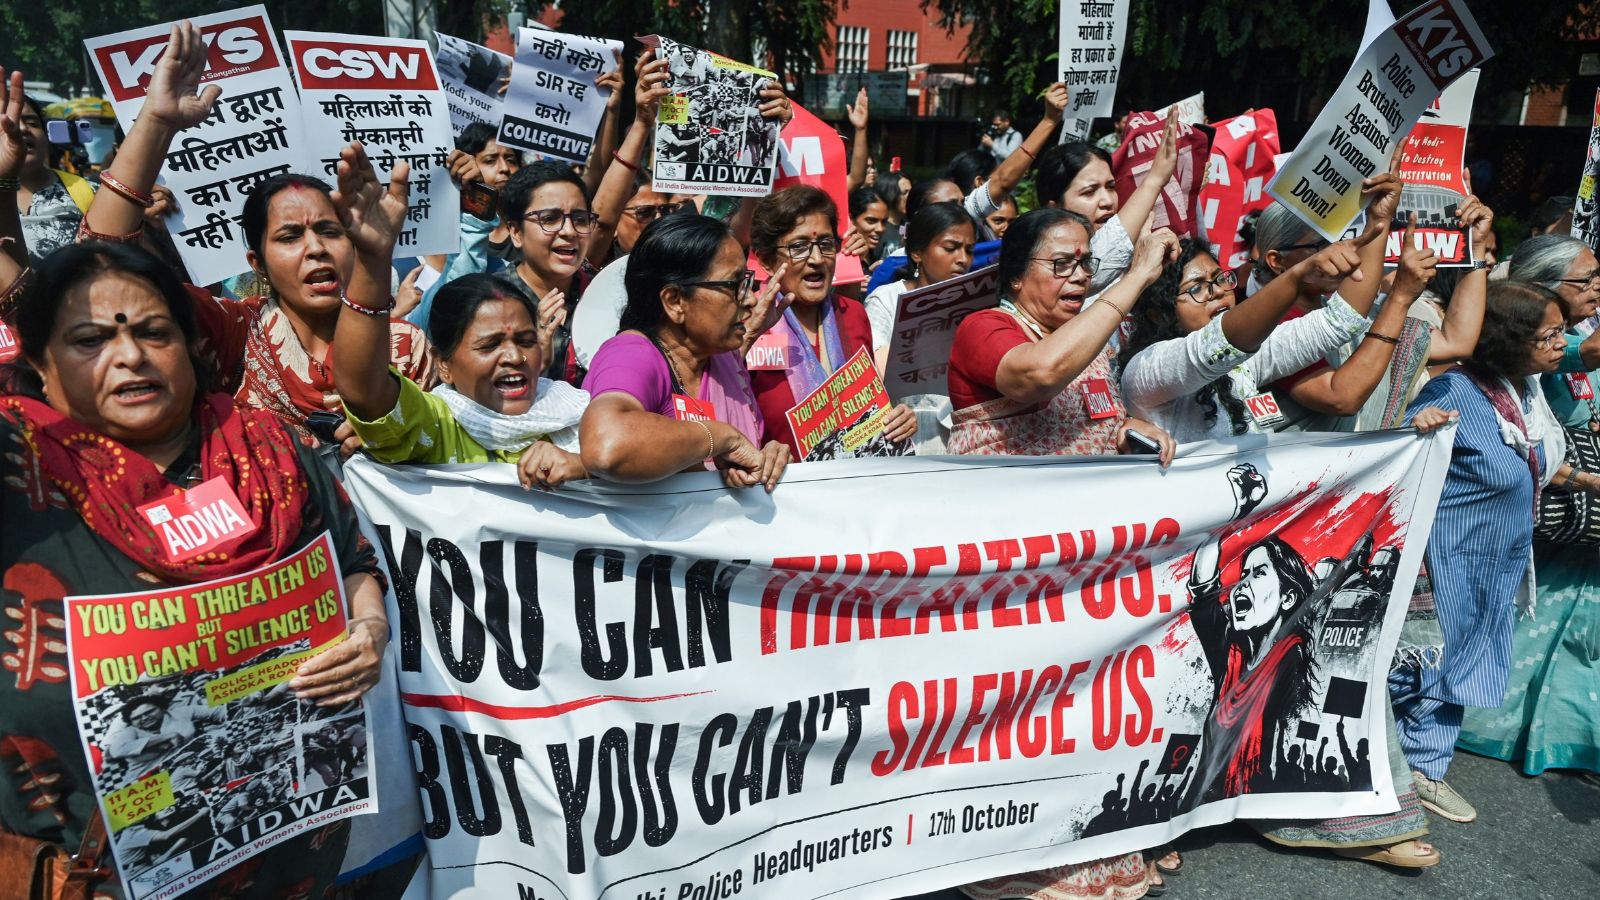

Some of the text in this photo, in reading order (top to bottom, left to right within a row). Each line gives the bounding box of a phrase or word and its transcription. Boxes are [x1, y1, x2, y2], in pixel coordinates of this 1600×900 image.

[1078, 20, 1115, 42] मांगती हैं
[1406, 5, 1473, 77] KYS
[302, 48, 420, 80] CSW
[533, 35, 568, 61] नहीं
[566, 47, 607, 75] सहेंगे,
[1071, 44, 1117, 63] हर प्रकार के
[206, 65, 251, 80] Sangathan
[535, 71, 564, 93] SIR
[1109, 67, 1118, 84] से
[1380, 53, 1416, 100] Police
[223, 86, 285, 123] द्वारा
[319, 94, 433, 121] महिलाओं को
[441, 79, 493, 113] Modi, your
[670, 106, 685, 114] OCT
[1356, 70, 1405, 134] Brutality
[534, 102, 572, 126] करो!
[1345, 102, 1392, 155] Against
[166, 116, 290, 173] महिलाओं
[340, 121, 424, 152] गैरकानूनी
[502, 121, 590, 157] COLLECTIVE
[1327, 125, 1377, 178] Women
[1409, 135, 1421, 149] by
[376, 149, 397, 173] से
[432, 146, 450, 169] में
[692, 165, 765, 184] AIDWA
[1413, 153, 1445, 168] Destroy
[413, 174, 432, 195] में
[680, 183, 713, 191] Democratic
[712, 185, 737, 193] Women's
[736, 186, 769, 194] Association
[1311, 156, 1352, 197] Down
[184, 179, 232, 208] का
[1289, 177, 1339, 220] Down!
[178, 209, 235, 250] नहीं
[906, 275, 999, 314] CSW
[746, 346, 785, 367] AIDWA
[793, 352, 871, 427] YOU CAN THREATEN US
[801, 376, 884, 454] YOU CAN'T SILENCE US
[1247, 394, 1280, 418] KYS
[846, 423, 883, 449] ASHOKA ROAD
[160, 499, 246, 556] AIDWA
[76, 545, 329, 638] YOU CAN THREATEN US
[374, 517, 1181, 691] YOU CAN THREATEN US.
[80, 588, 339, 692] YOU CAN'T SILENCE US
[196, 617, 224, 638] BUT
[1323, 626, 1364, 649] POLICE
[210, 673, 256, 694] POLICE
[213, 678, 265, 702] ASHOKA
[410, 644, 1165, 875] BUT YOU CAN'T SILENCE US.
[107, 777, 164, 806] 11 A.M.
[111, 788, 163, 816] 17 OCT
[126, 802, 154, 821] SAT
[206, 784, 359, 864] AIDWA
[154, 801, 370, 900] India Democratic Women's Association
[678, 868, 744, 900] Police
[753, 824, 894, 887] Headquarters
[928, 812, 957, 838] 17th
[961, 800, 1040, 834] October
